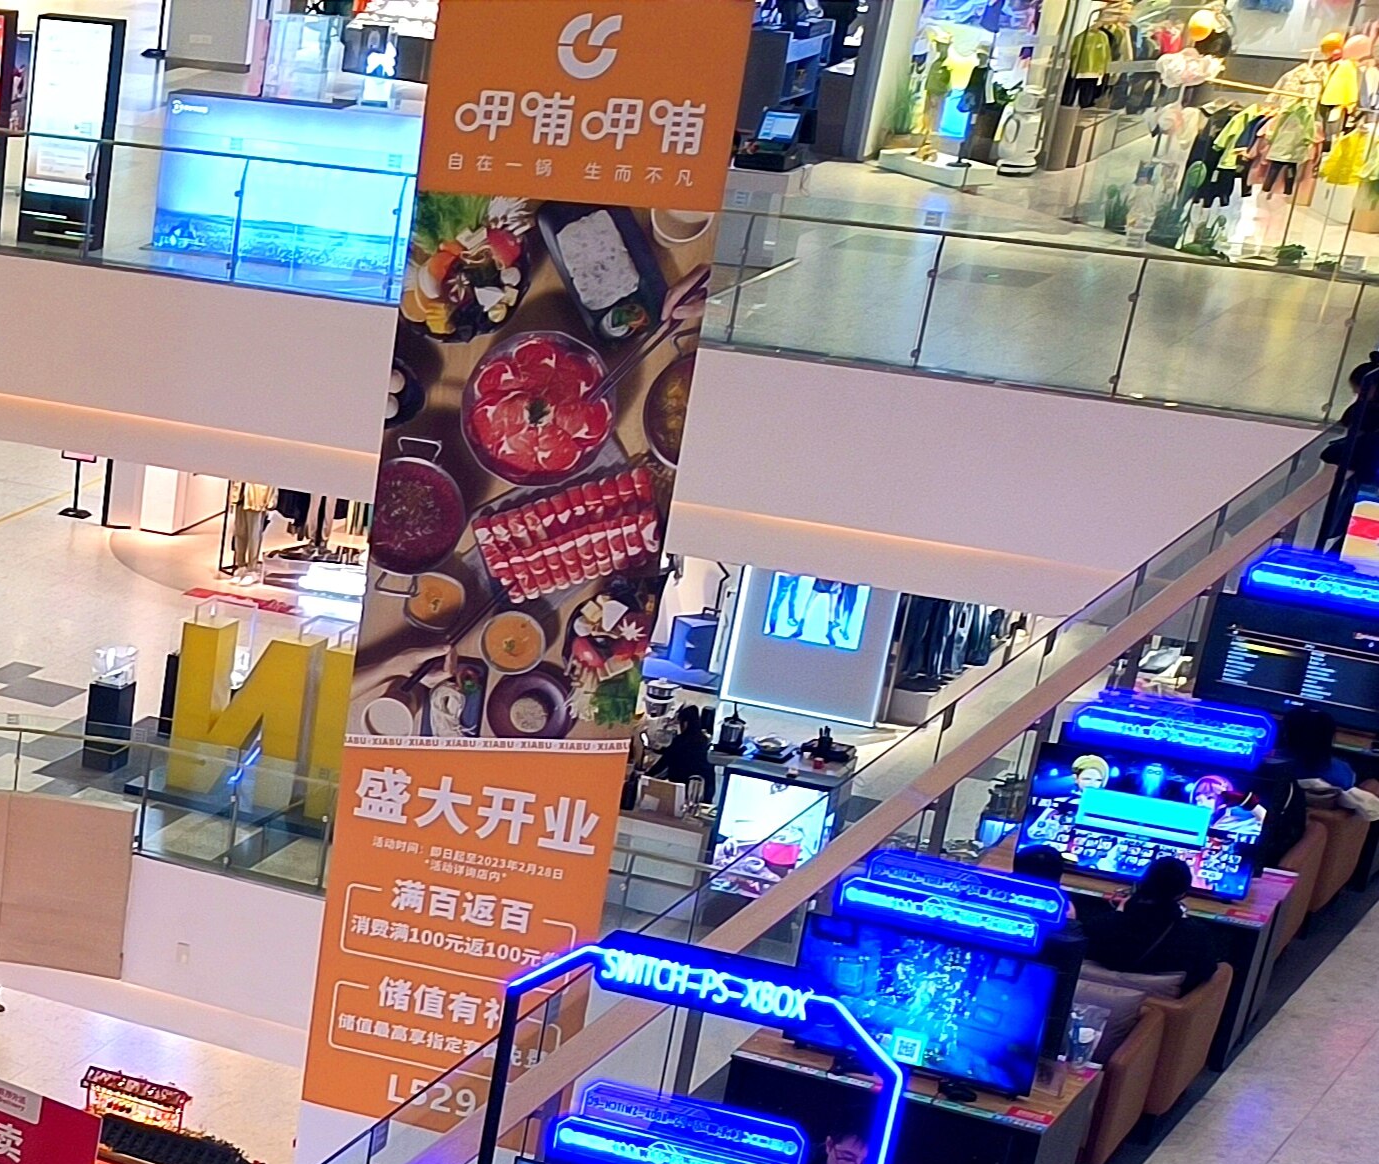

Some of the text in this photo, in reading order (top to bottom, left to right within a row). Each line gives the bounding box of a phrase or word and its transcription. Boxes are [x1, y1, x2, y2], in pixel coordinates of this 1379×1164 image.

[447, 152, 694, 187] 自在一锅 生而不凡
[353, 766, 600, 855] 盛大开业
[391, 878, 534, 934] 满百返百
[387, 1073, 477, 1118] L529
